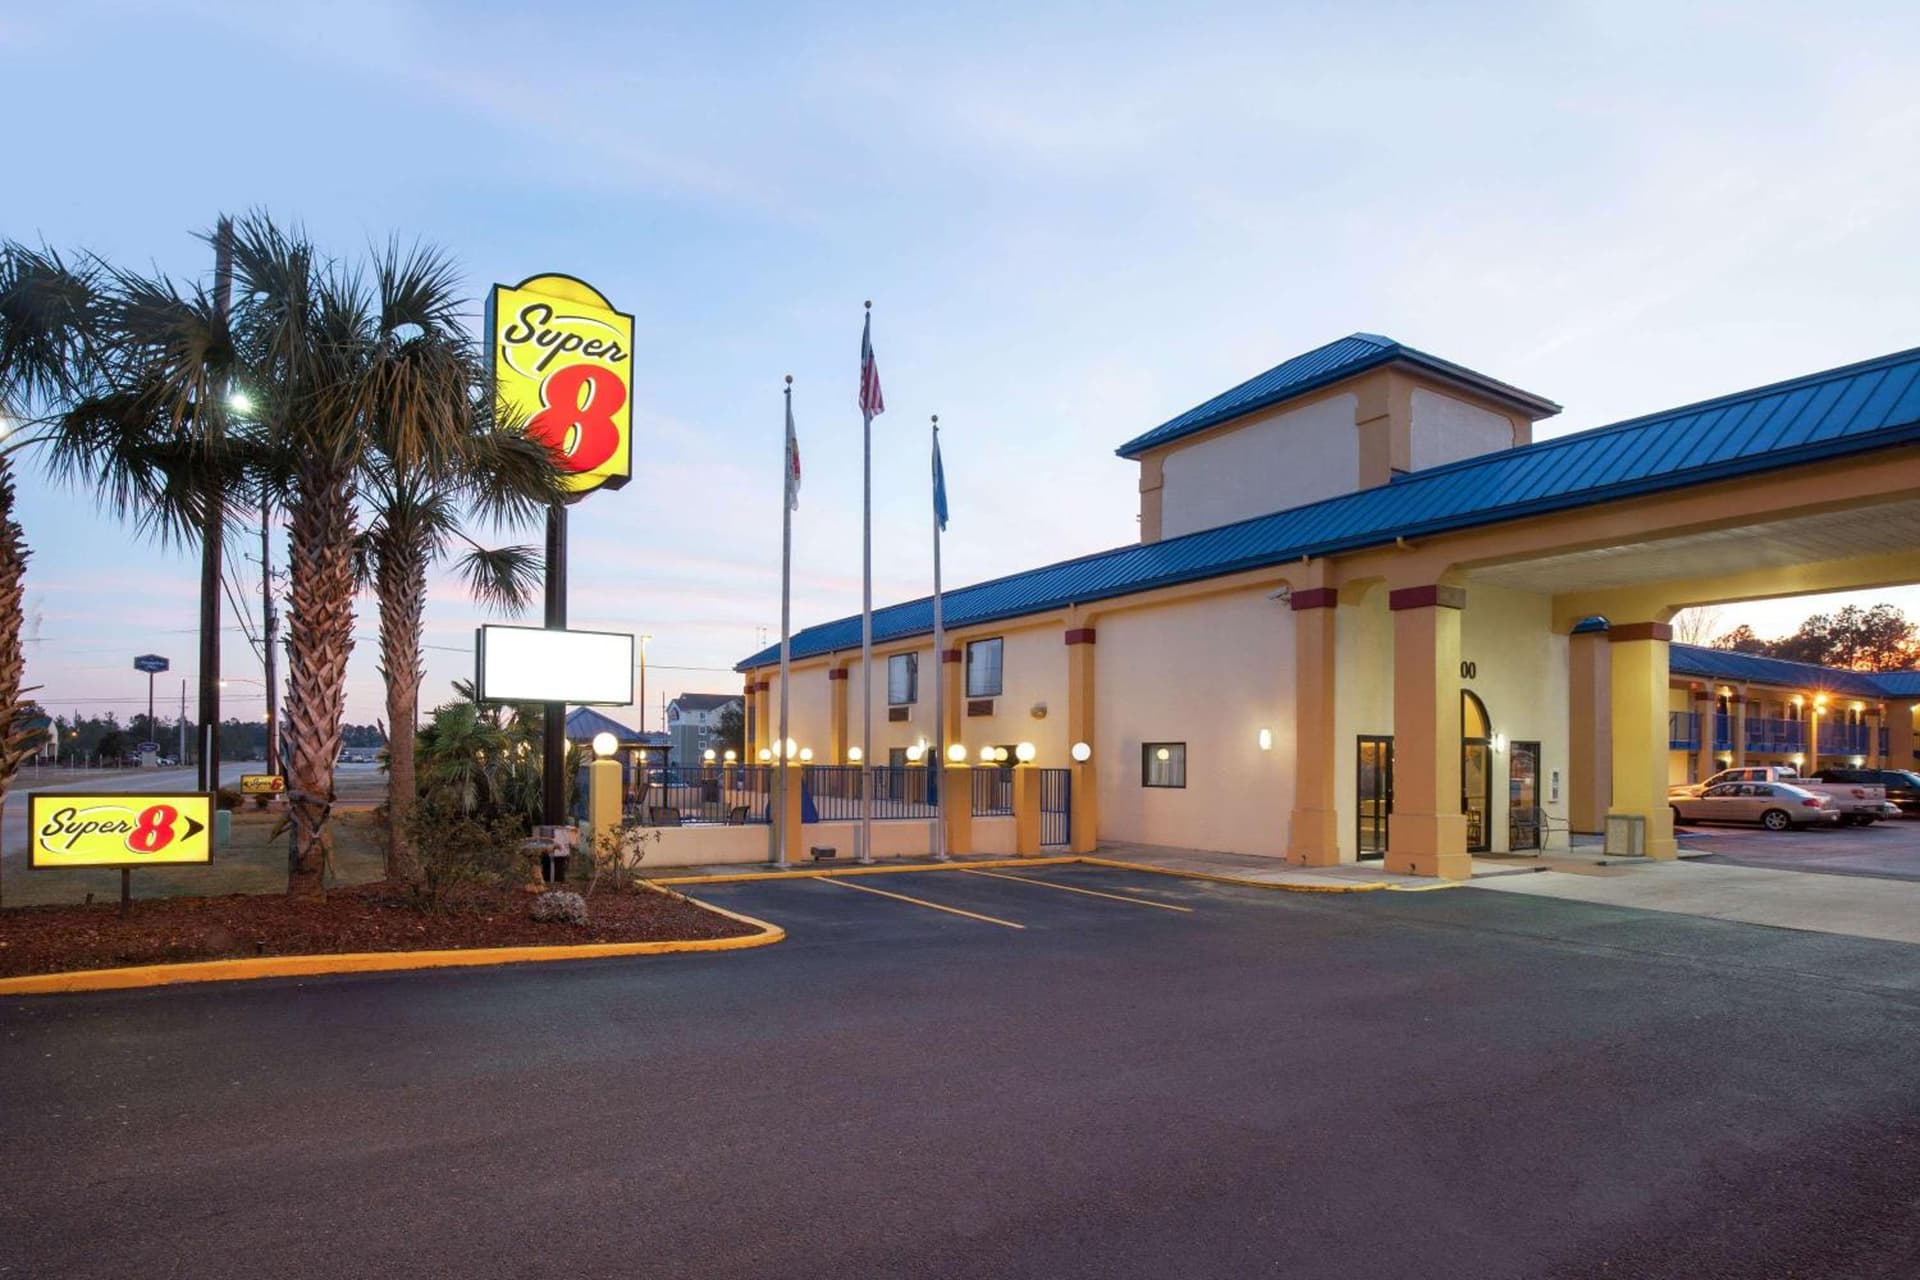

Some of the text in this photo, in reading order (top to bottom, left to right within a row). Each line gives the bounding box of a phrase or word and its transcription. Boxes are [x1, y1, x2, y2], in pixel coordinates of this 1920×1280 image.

[504, 303, 628, 372] Super
[523, 363, 627, 473] 8
[42, 804, 178, 853] Super 8
